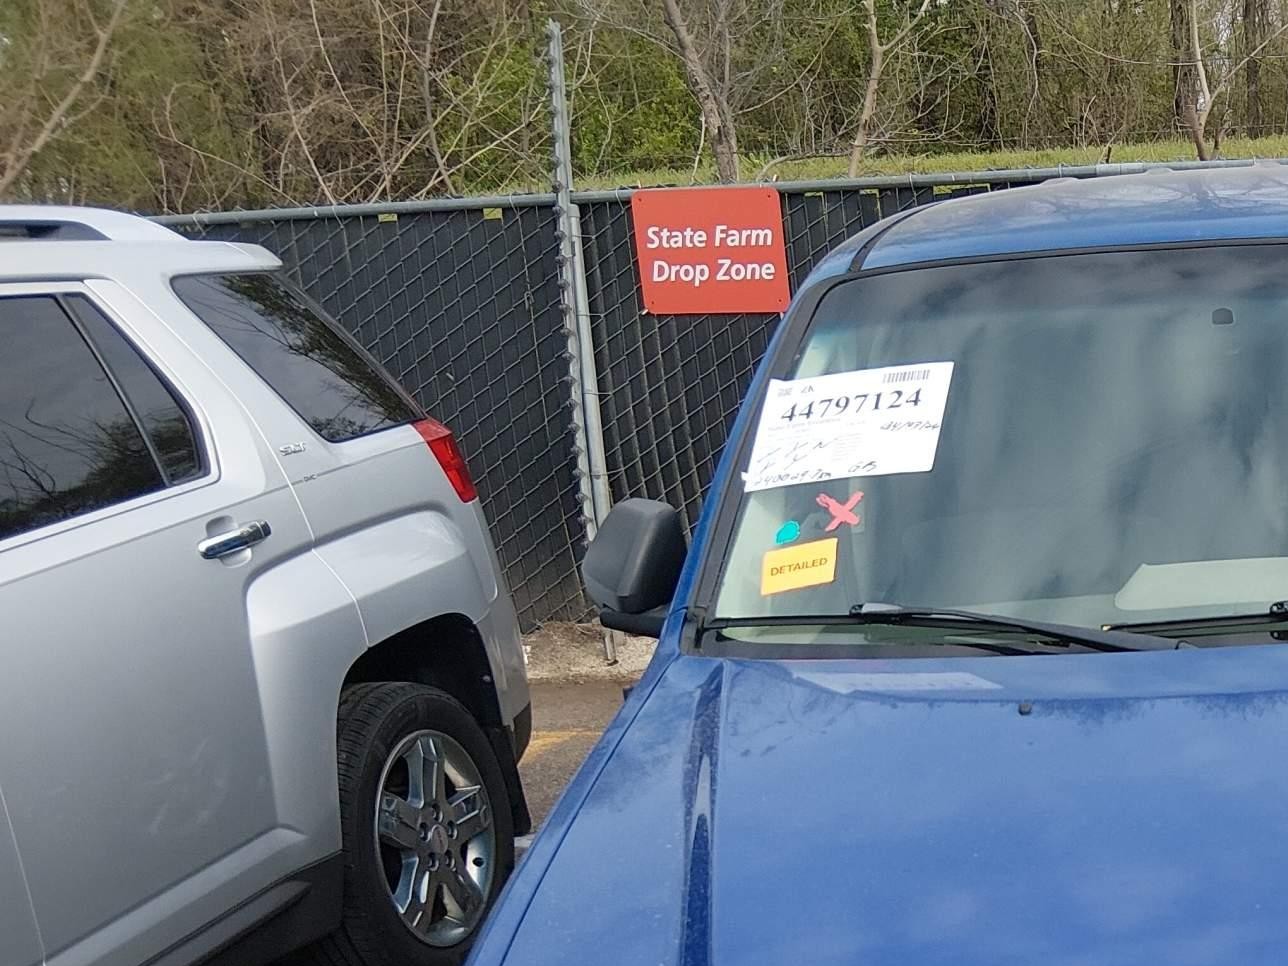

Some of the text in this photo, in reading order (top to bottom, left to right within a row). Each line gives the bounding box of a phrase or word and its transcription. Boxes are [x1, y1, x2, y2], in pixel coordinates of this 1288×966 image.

[646, 225, 773, 249] State Farm
[652, 258, 776, 287] Drop Zone
[781, 387, 922, 421] 44797124
[769, 556, 828, 577] DETAILED
